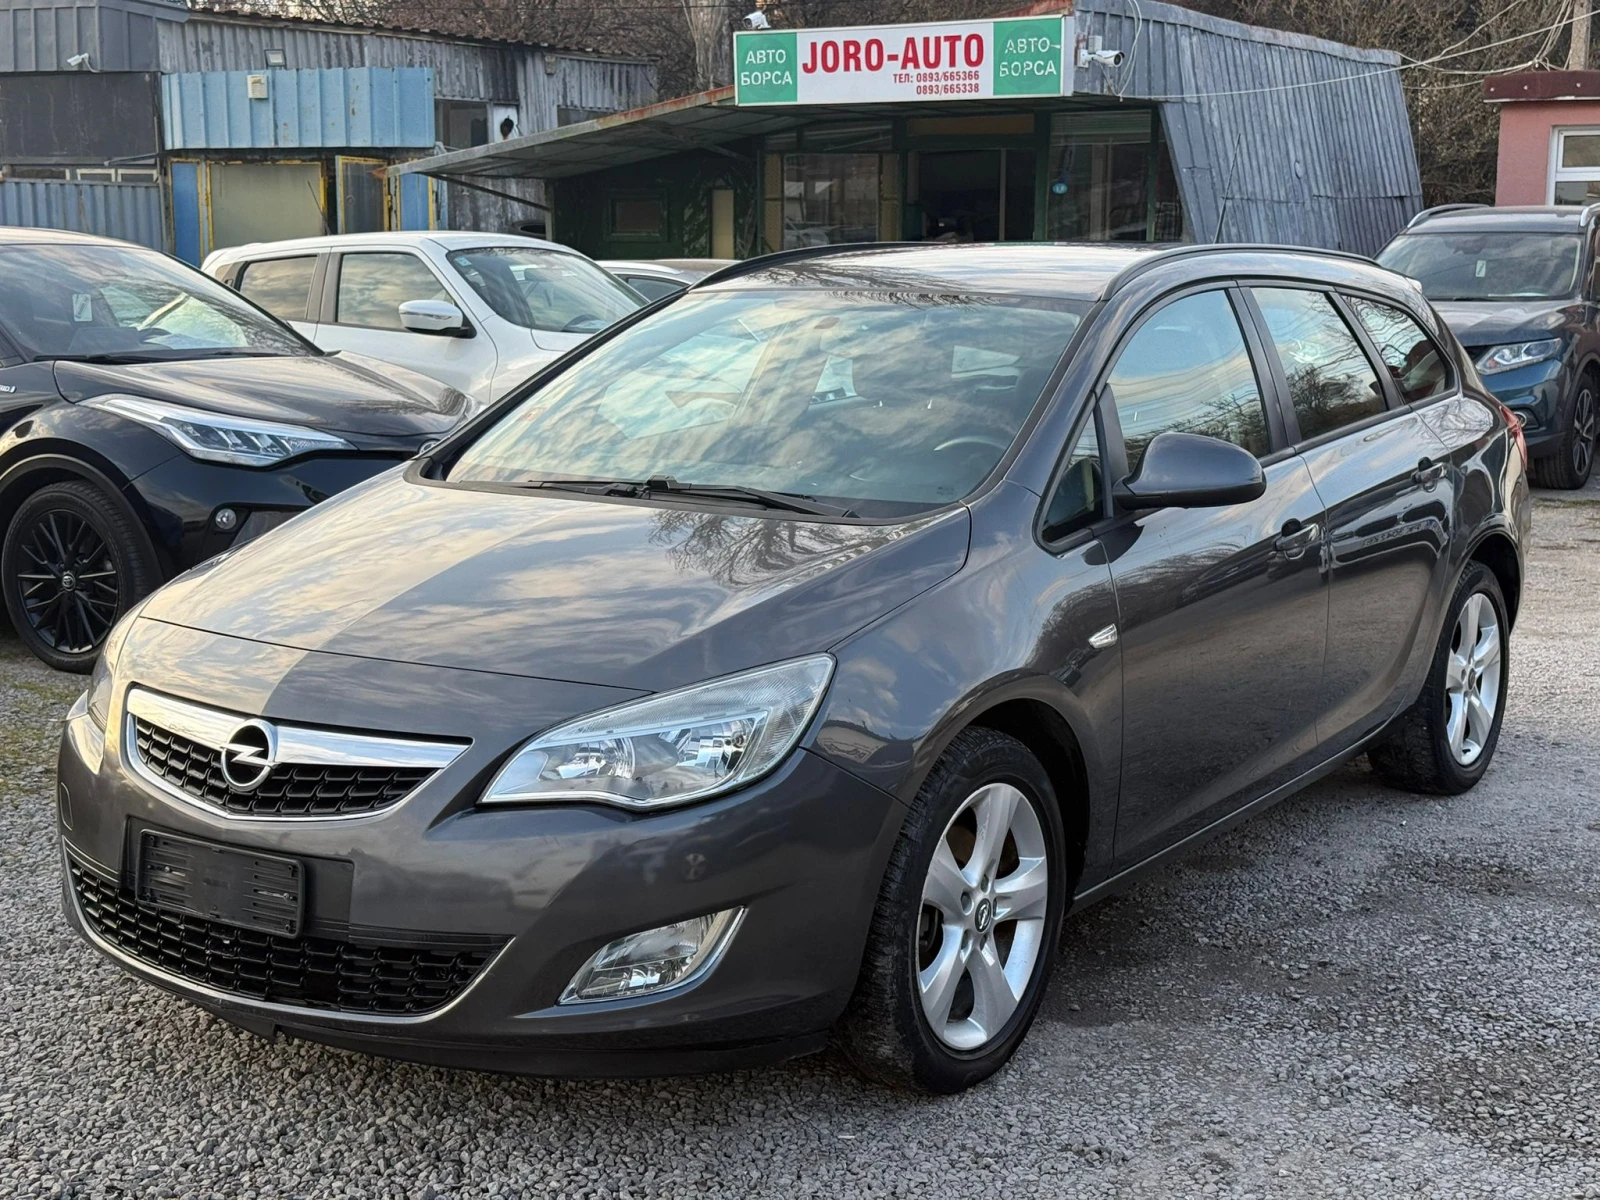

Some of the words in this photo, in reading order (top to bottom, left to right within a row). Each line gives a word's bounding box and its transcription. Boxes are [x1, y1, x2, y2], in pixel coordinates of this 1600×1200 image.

[745, 49, 787, 65] АВТО
[802, 34, 984, 74] JORO-AUTO
[999, 60, 1057, 77] БОРСА
[741, 70, 793, 86] БОРСА
[893, 73, 914, 84] ТЕЛ:
[916, 70, 980, 83] 0893/665366
[916, 83, 980, 96] 0893/665338
